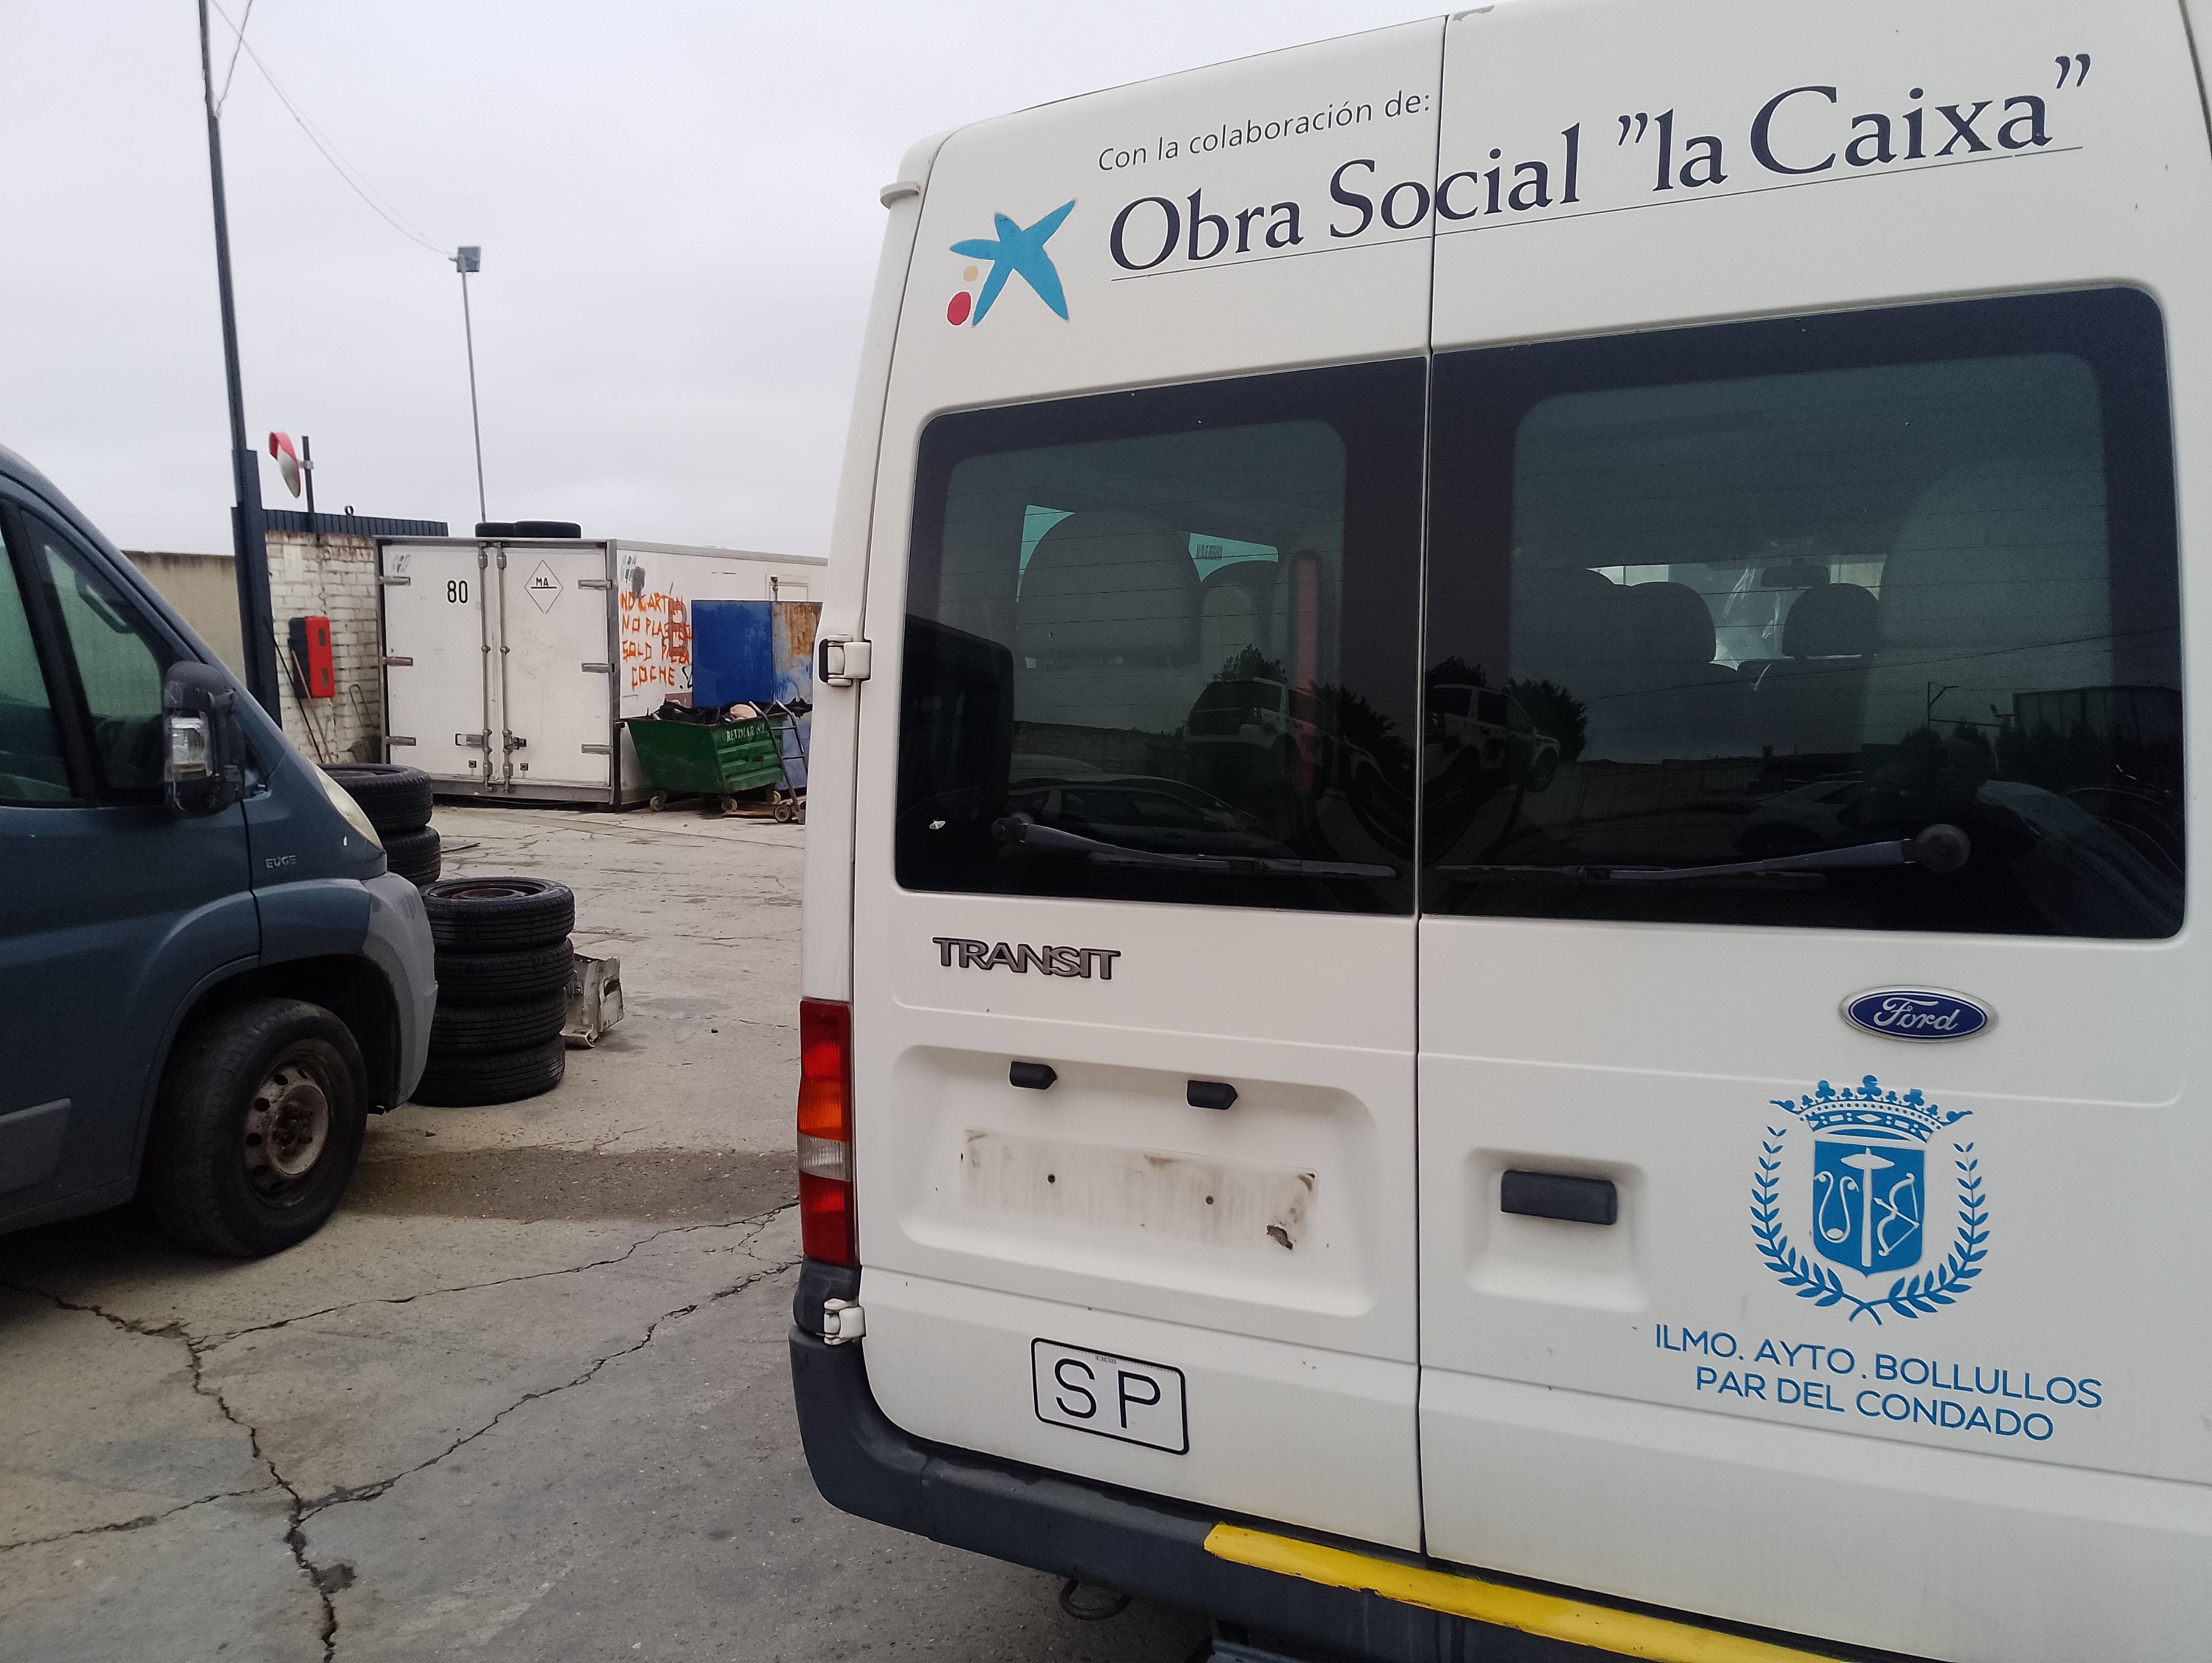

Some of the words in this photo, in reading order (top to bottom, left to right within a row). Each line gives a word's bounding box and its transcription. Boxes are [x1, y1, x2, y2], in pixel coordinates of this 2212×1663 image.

[1098, 147, 1147, 171] Con
[1158, 137, 1179, 161] la
[1189, 101, 1373, 154] colaboración
[1384, 90, 1430, 118] de:
[1109, 187, 1304, 271] Obra
[1329, 122, 1581, 238] Social
[447, 580, 468, 603] 80
[536, 577, 549, 586] MA
[622, 613, 641, 634] NO
[631, 665, 675, 691] COCHE
[726, 726, 754, 741] REVIMAR
[932, 937, 1121, 979] TRANSIT
[1873, 997, 1961, 1030] Ford
[1656, 1324, 1744, 1360] ILMO.
[1697, 1366, 1766, 1400] PAR
[1777, 1378, 1844, 1412] DEL
[1857, 1391, 2053, 1441] CONDADO
